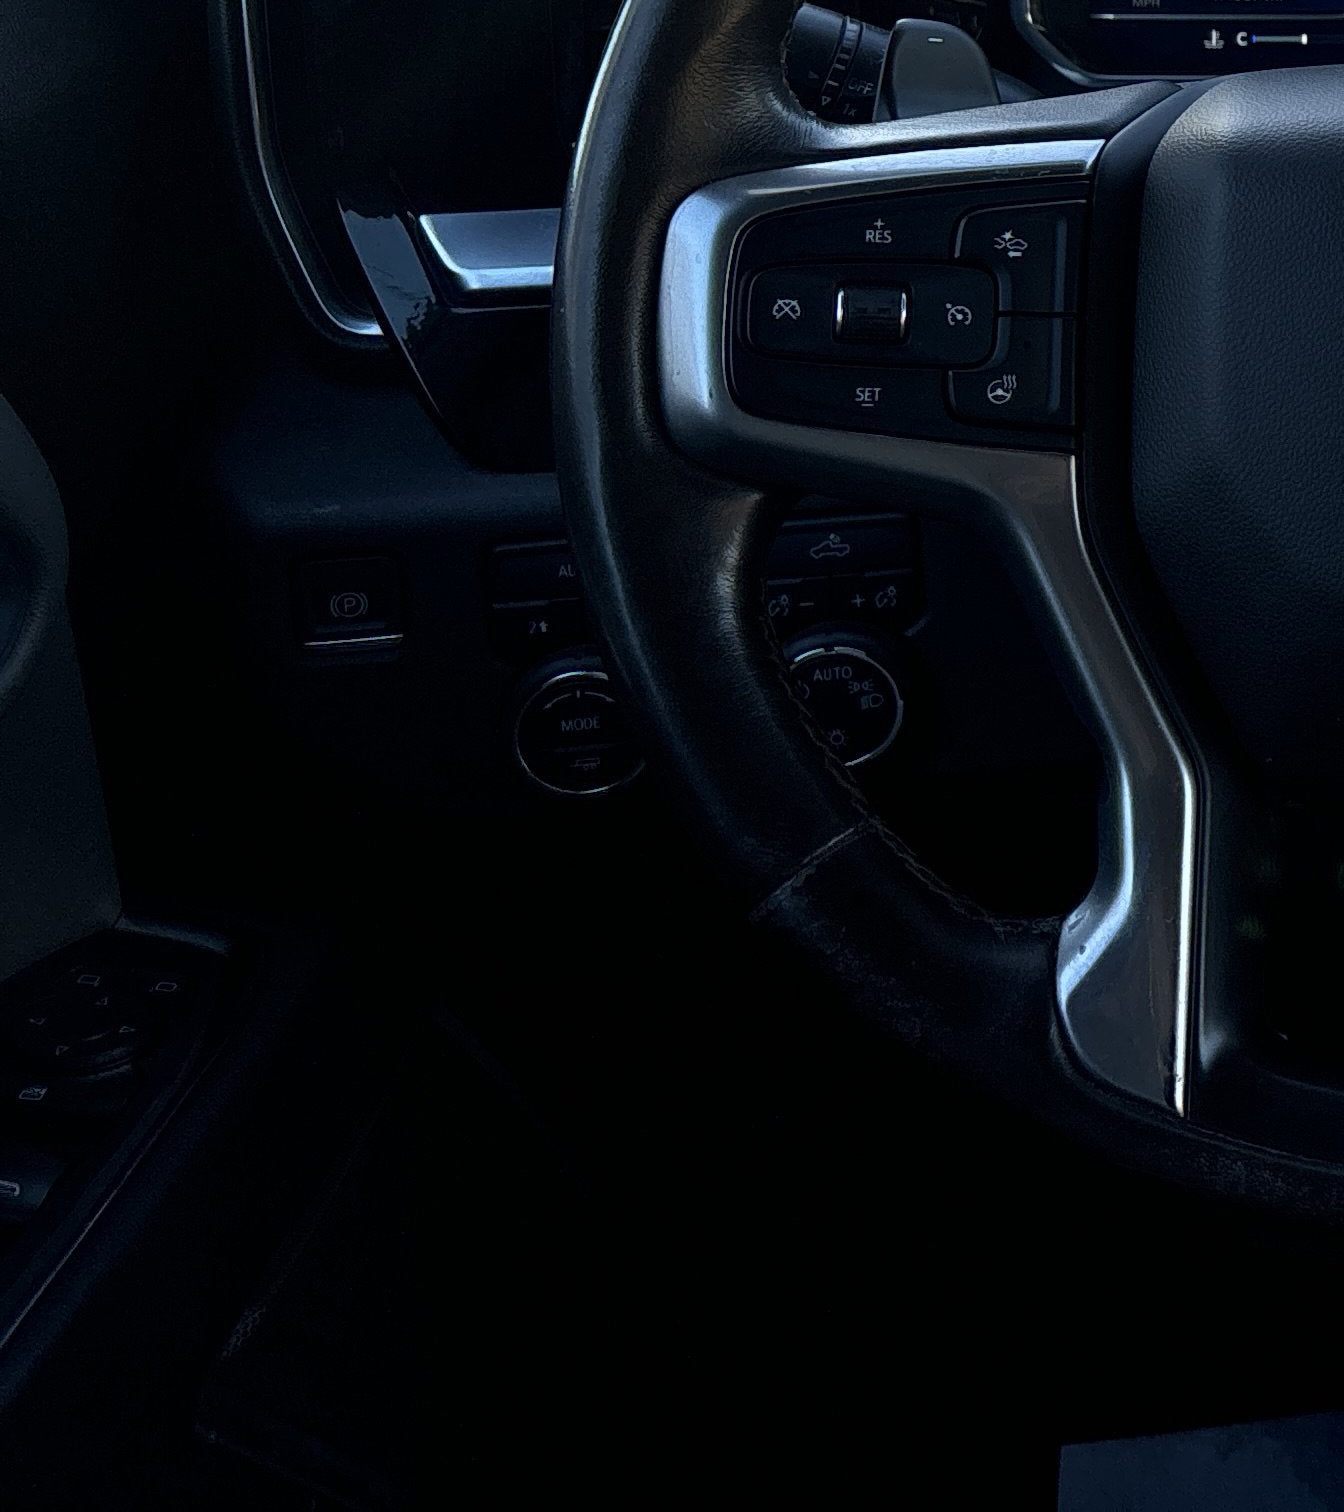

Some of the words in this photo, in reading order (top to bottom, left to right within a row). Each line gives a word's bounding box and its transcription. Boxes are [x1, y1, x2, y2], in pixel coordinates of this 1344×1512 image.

[1236, 31, 1248, 47] C
[865, 230, 892, 244] RES
[855, 387, 881, 402] SET
[813, 665, 852, 681] AUTO
[560, 717, 600, 733] MODE
